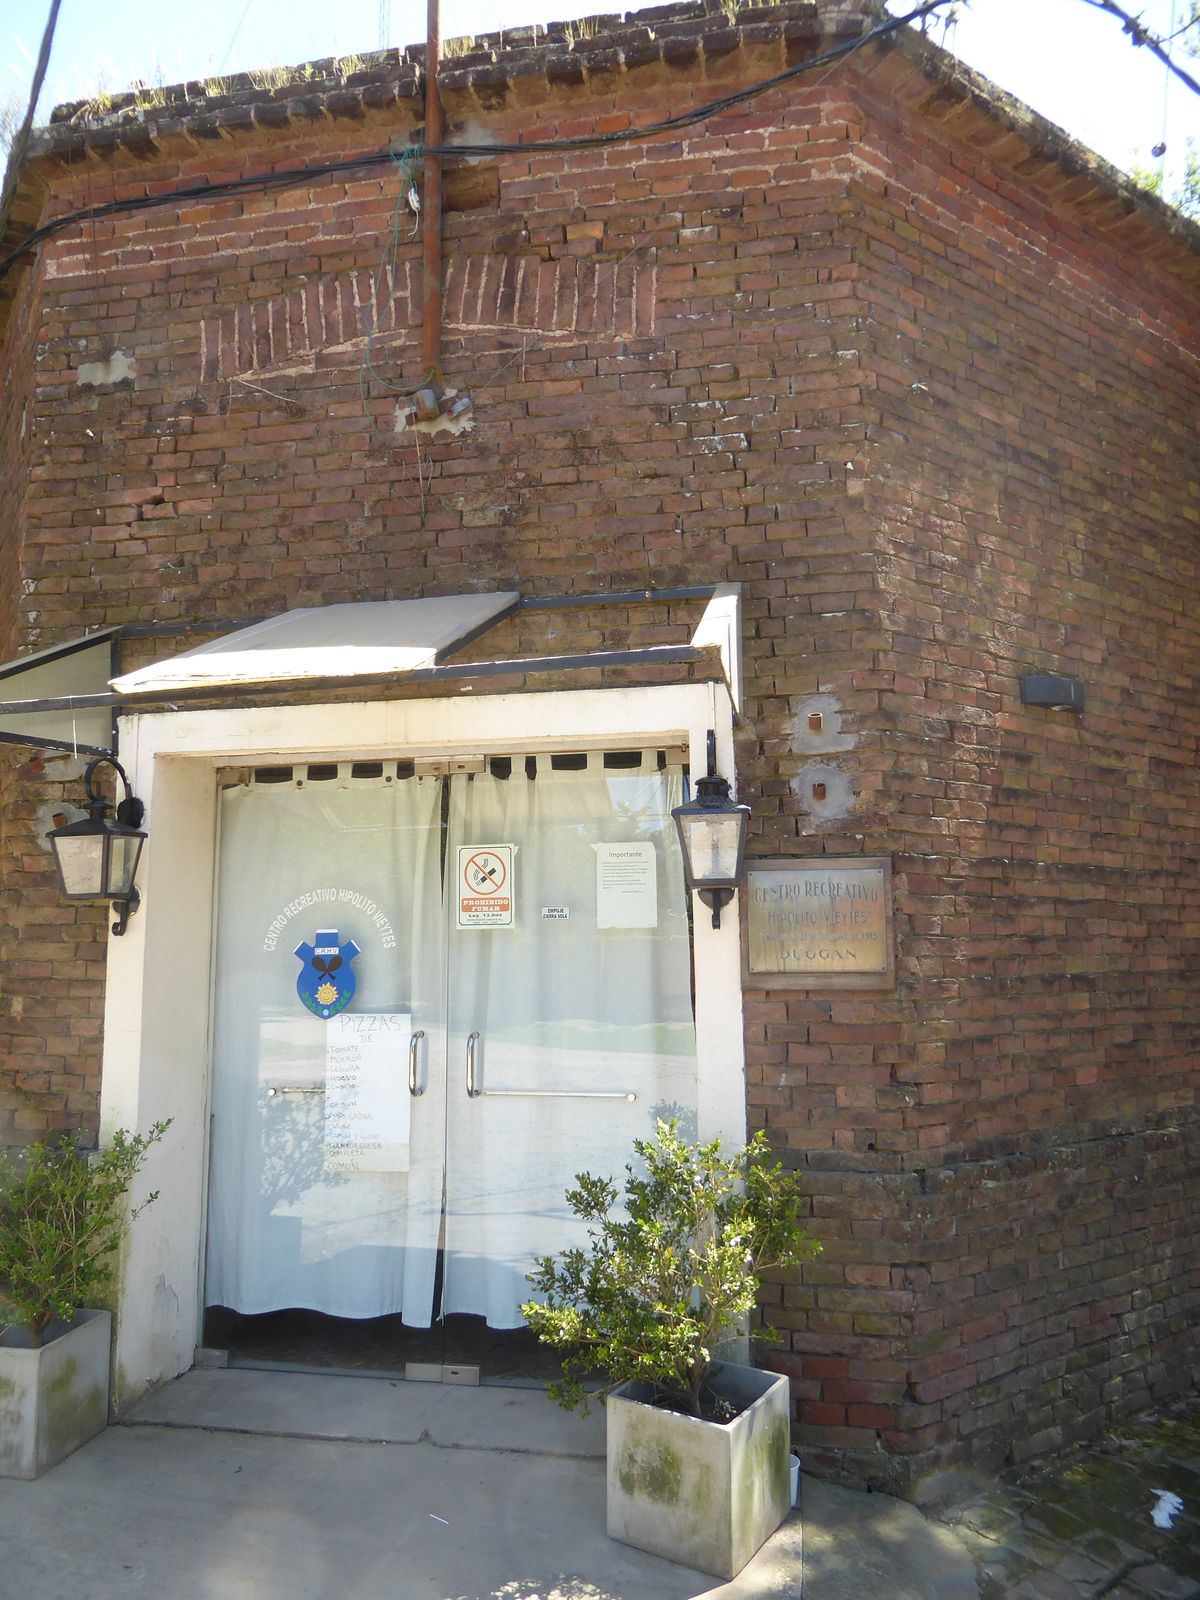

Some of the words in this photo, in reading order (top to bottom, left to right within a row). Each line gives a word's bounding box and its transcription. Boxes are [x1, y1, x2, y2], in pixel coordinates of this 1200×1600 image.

[755, 884, 800, 904] CENTRO
[804, 880, 878, 902] RECREATIVO
[263, 915, 288, 952] CENTRO
[284, 888, 337, 920] RECREATIVO
[338, 888, 377, 915] HIPOLITO
[371, 909, 397, 949] VIEYTES
[780, 949, 856, 961] DUGGAN
[338, 1015, 401, 1033] PIZZAS
[359, 1034, 374, 1043] DE
[329, 1150, 364, 1158] COMPLETA
